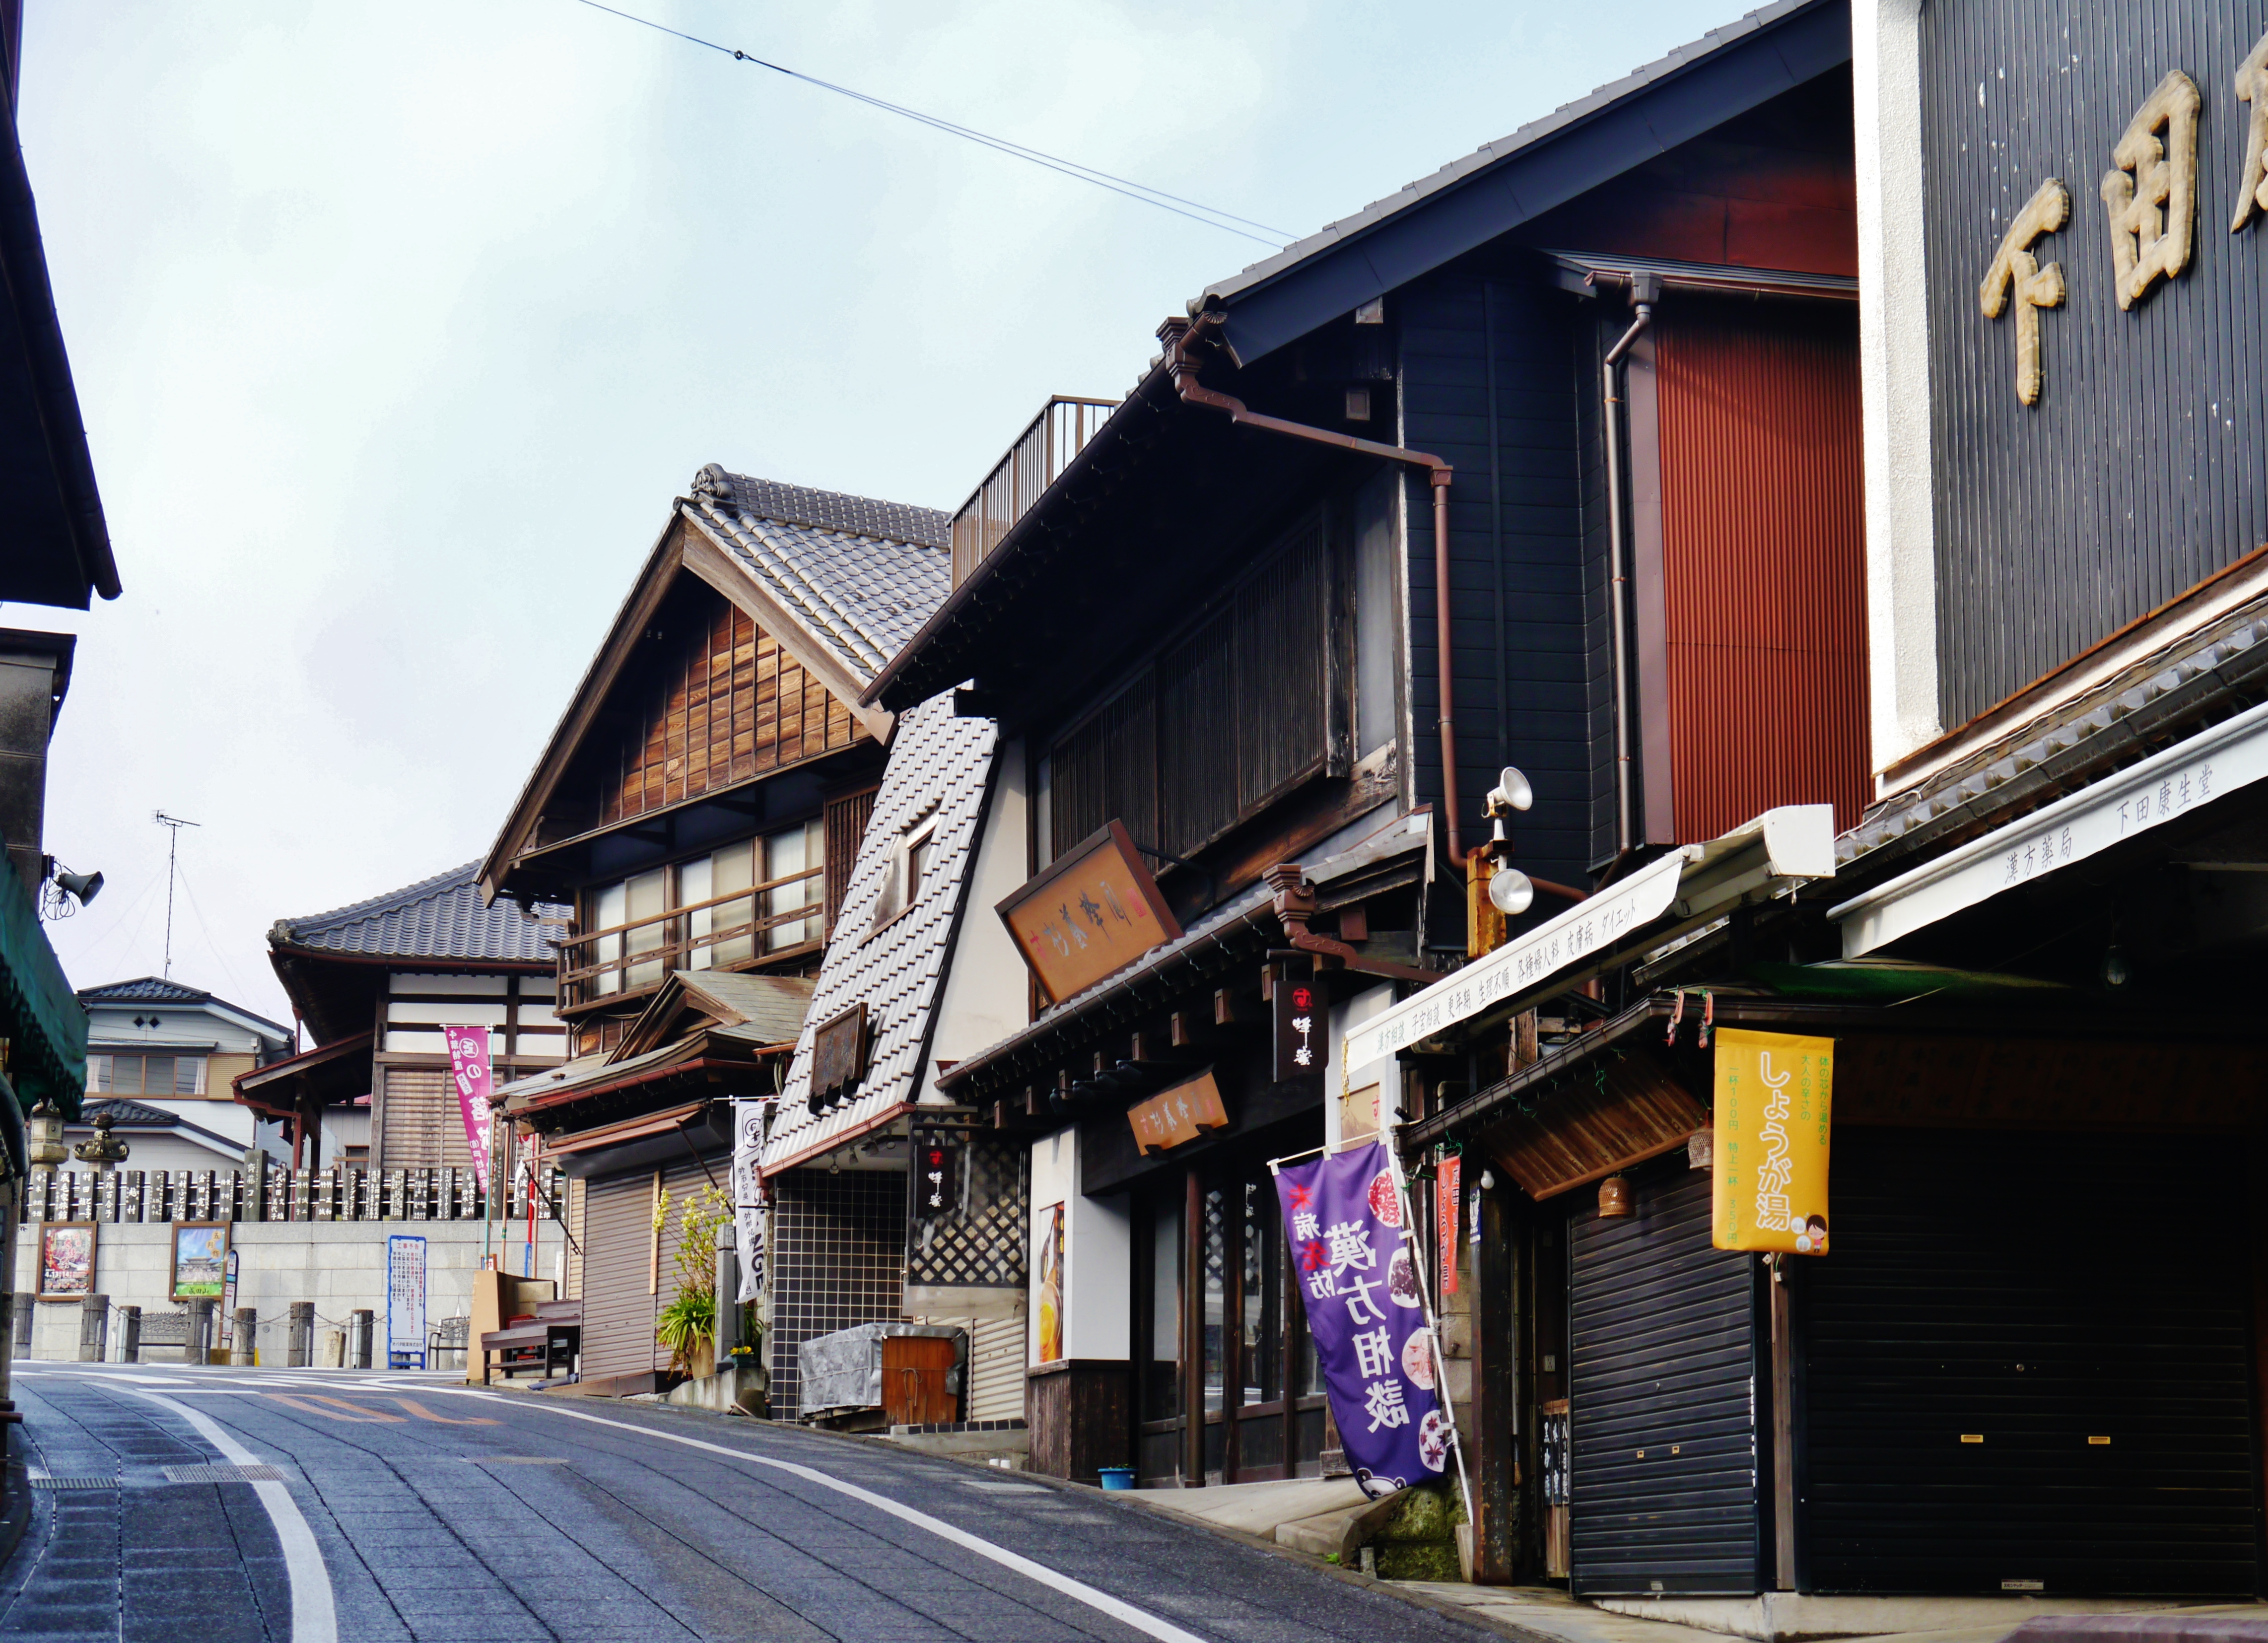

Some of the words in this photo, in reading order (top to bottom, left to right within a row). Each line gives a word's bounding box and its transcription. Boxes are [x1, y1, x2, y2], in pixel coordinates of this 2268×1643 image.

[2005, 827, 2072, 885] 漢方薬局
[2117, 763, 2213, 834] 下田康生堂
[1376, 1020, 1405, 1054] 漢方相談
[1412, 1004, 1441, 1037] 子宝相談
[1448, 988, 1471, 1020] 更年期
[1479, 966, 1510, 1005] 生理不順
[1517, 941, 1560, 983] 各種婦人科
[1567, 920, 1593, 957] 皮膚病
[1601, 898, 1636, 939] ダイエット
[1800, 1055, 1811, 1121] 大人の辛さの
[1818, 1056, 1830, 1146] 体の芯から温める
[1727, 1142, 1739, 1187] 特上一杯
[1756, 1051, 1792, 1232] しょうが湯
[58, 1172, 70, 1220] 成毛家旅館
[82, 1172, 92, 1193] 村田
[105, 1171, 115, 1219] 大塚百合子
[176, 1171, 187, 1221] 川村ふとん店
[1727, 1199, 1738, 1244] 350円
